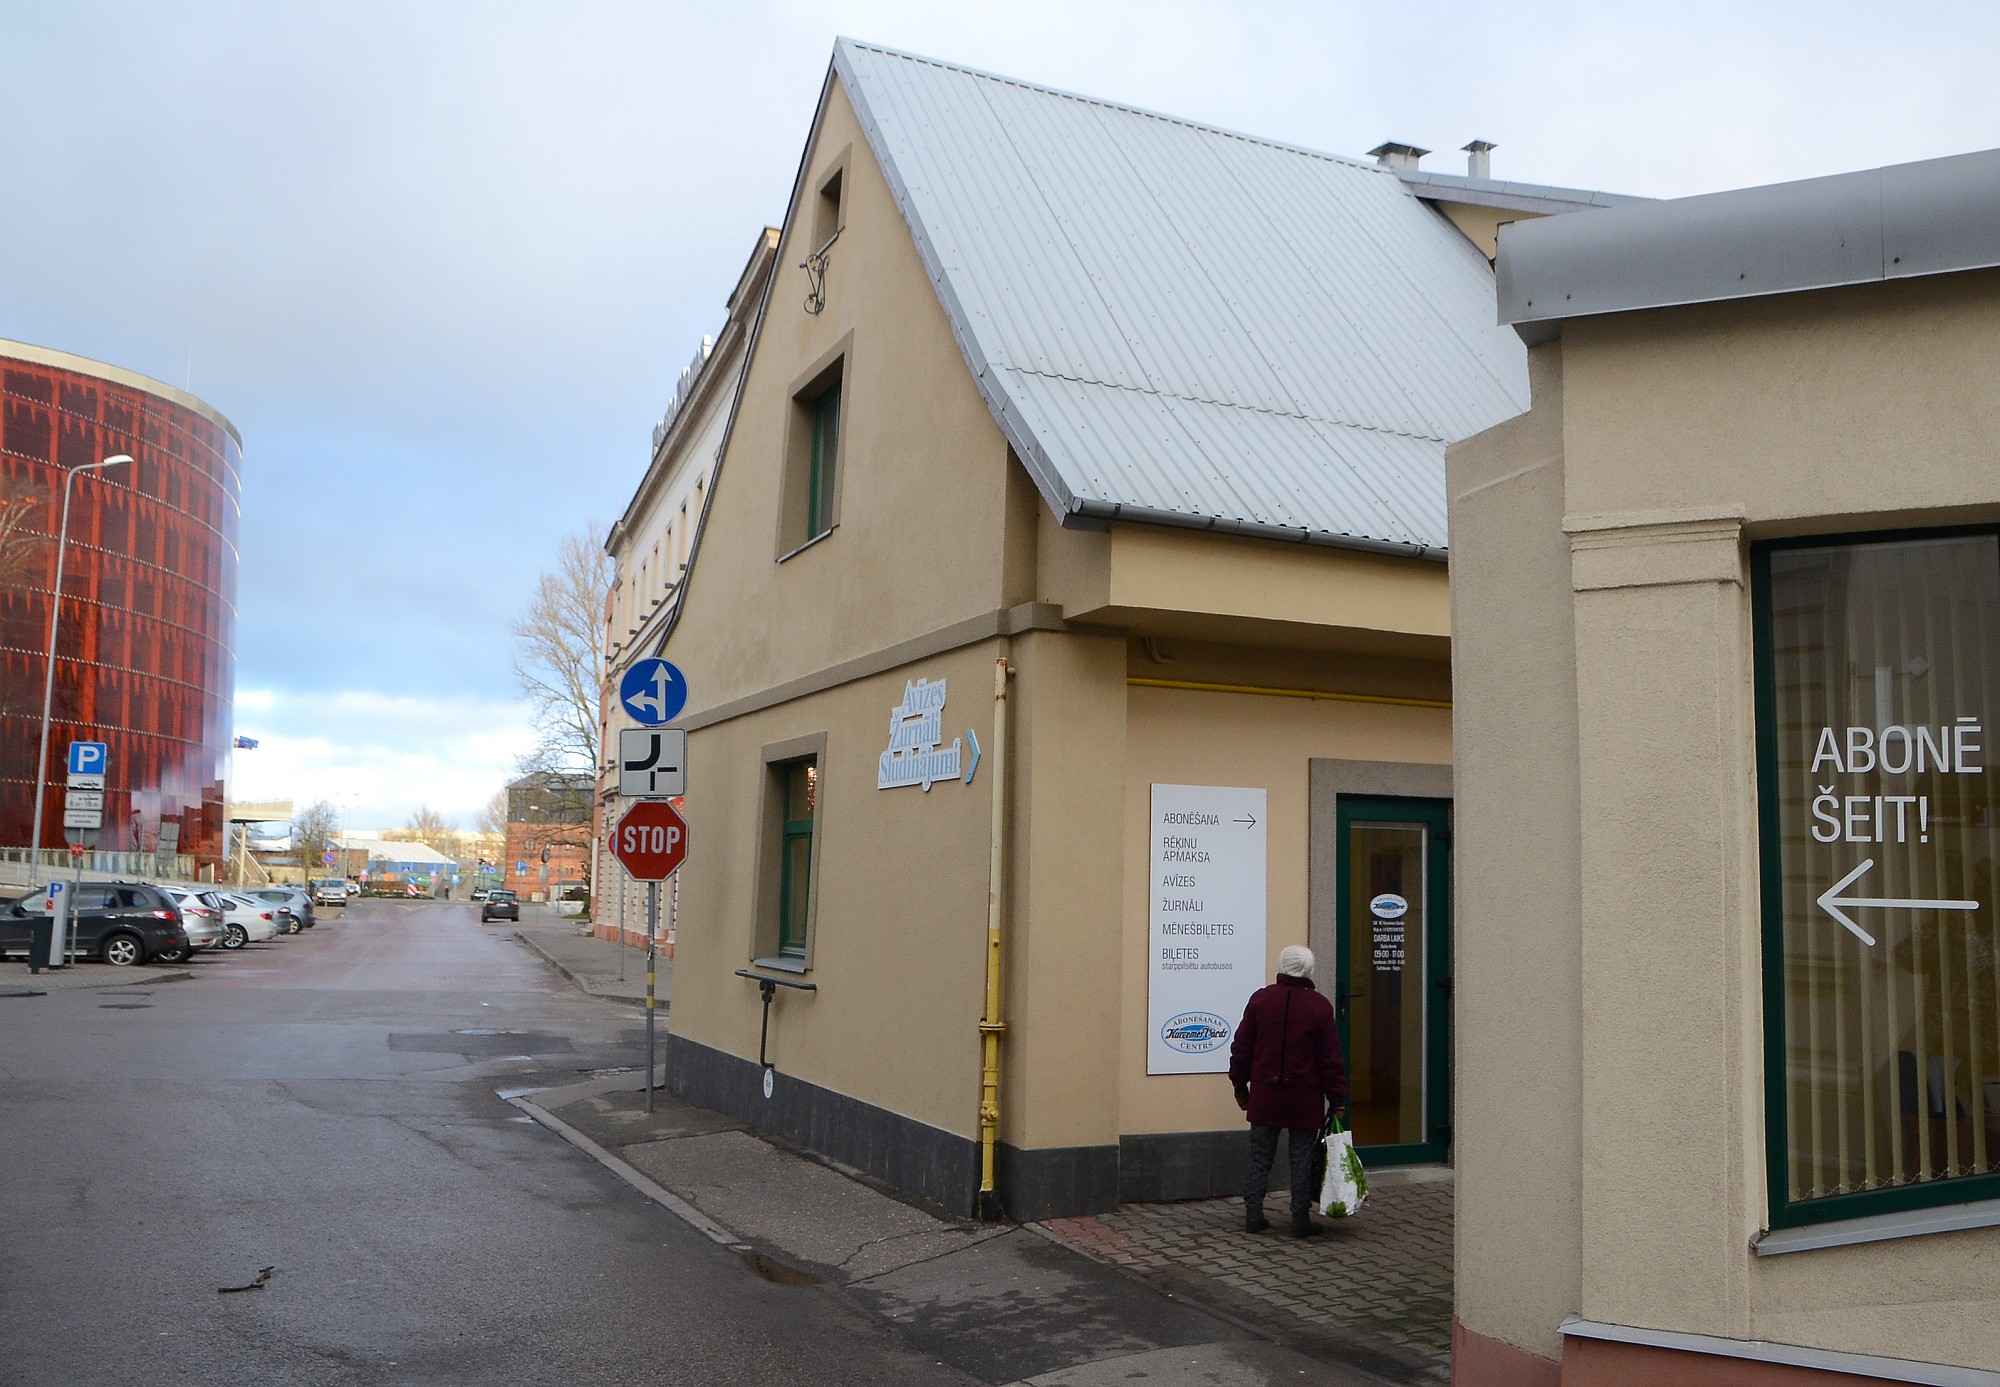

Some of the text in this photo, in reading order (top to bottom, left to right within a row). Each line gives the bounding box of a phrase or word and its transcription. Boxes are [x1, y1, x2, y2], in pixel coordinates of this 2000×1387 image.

[902, 683, 944, 713] Avīzes
[890, 713, 939, 749] Žurnāli
[1811, 716, 1982, 774] ABONĒ
[78, 745, 100, 772] P
[1163, 812, 1220, 826] ABONĒŠANA
[1811, 785, 1929, 843] ŠEIT!
[623, 825, 680, 855] STOP
[1163, 851, 1211, 863] APMAKSA
[1163, 874, 1196, 887] AVĪZES
[1162, 897, 1203, 912] ŽURNĀLI
[1162, 921, 1234, 938] MĒNEŠBIĻETES
[1162, 947, 1199, 962] BIĻETES
[1200, 962, 1233, 970] autobusos
[1180, 1041, 1213, 1050] CENTRS
